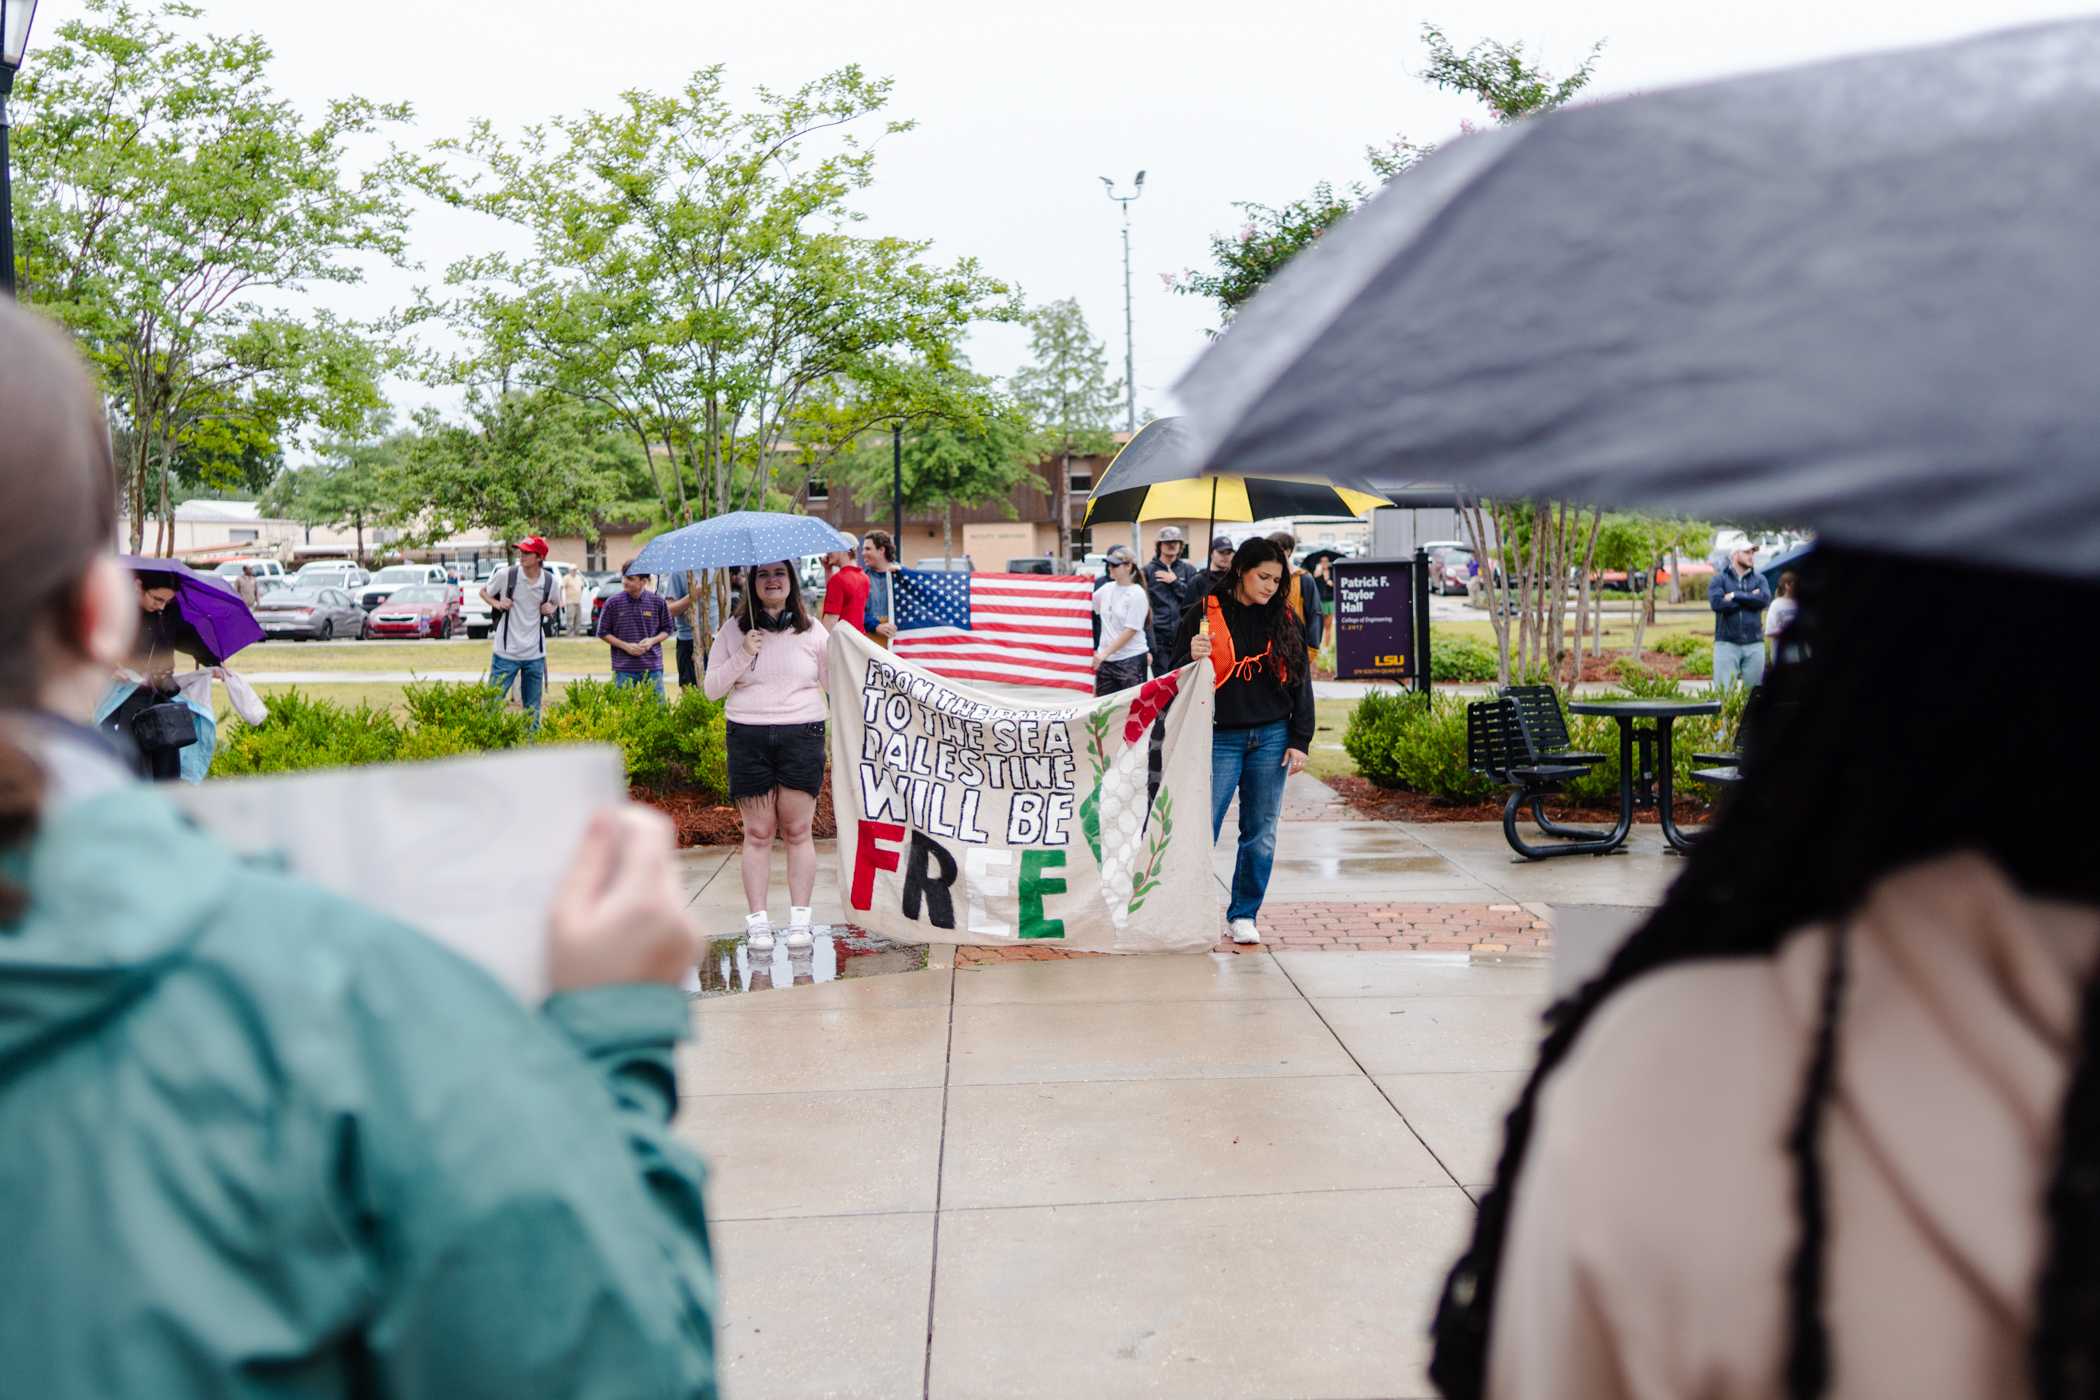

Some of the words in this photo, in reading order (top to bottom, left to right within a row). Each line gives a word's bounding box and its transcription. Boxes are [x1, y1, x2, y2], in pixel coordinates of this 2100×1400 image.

[1341, 576, 1379, 588] Patrick
[1380, 576, 1390, 587] F.
[1341, 589, 1375, 602] Taylor
[1341, 601, 1363, 613] Hall
[865, 658, 936, 704] FROM
[935, 688, 991, 721] THE
[1375, 655, 1404, 666] LSU
[862, 686, 913, 732] TO
[919, 704, 985, 750] THE
[992, 720, 1073, 754] SEA
[861, 724, 1076, 789] PALESTINE
[860, 763, 989, 844] WILL
[1007, 791, 1075, 845] BE
[850, 819, 1068, 940] FREE
